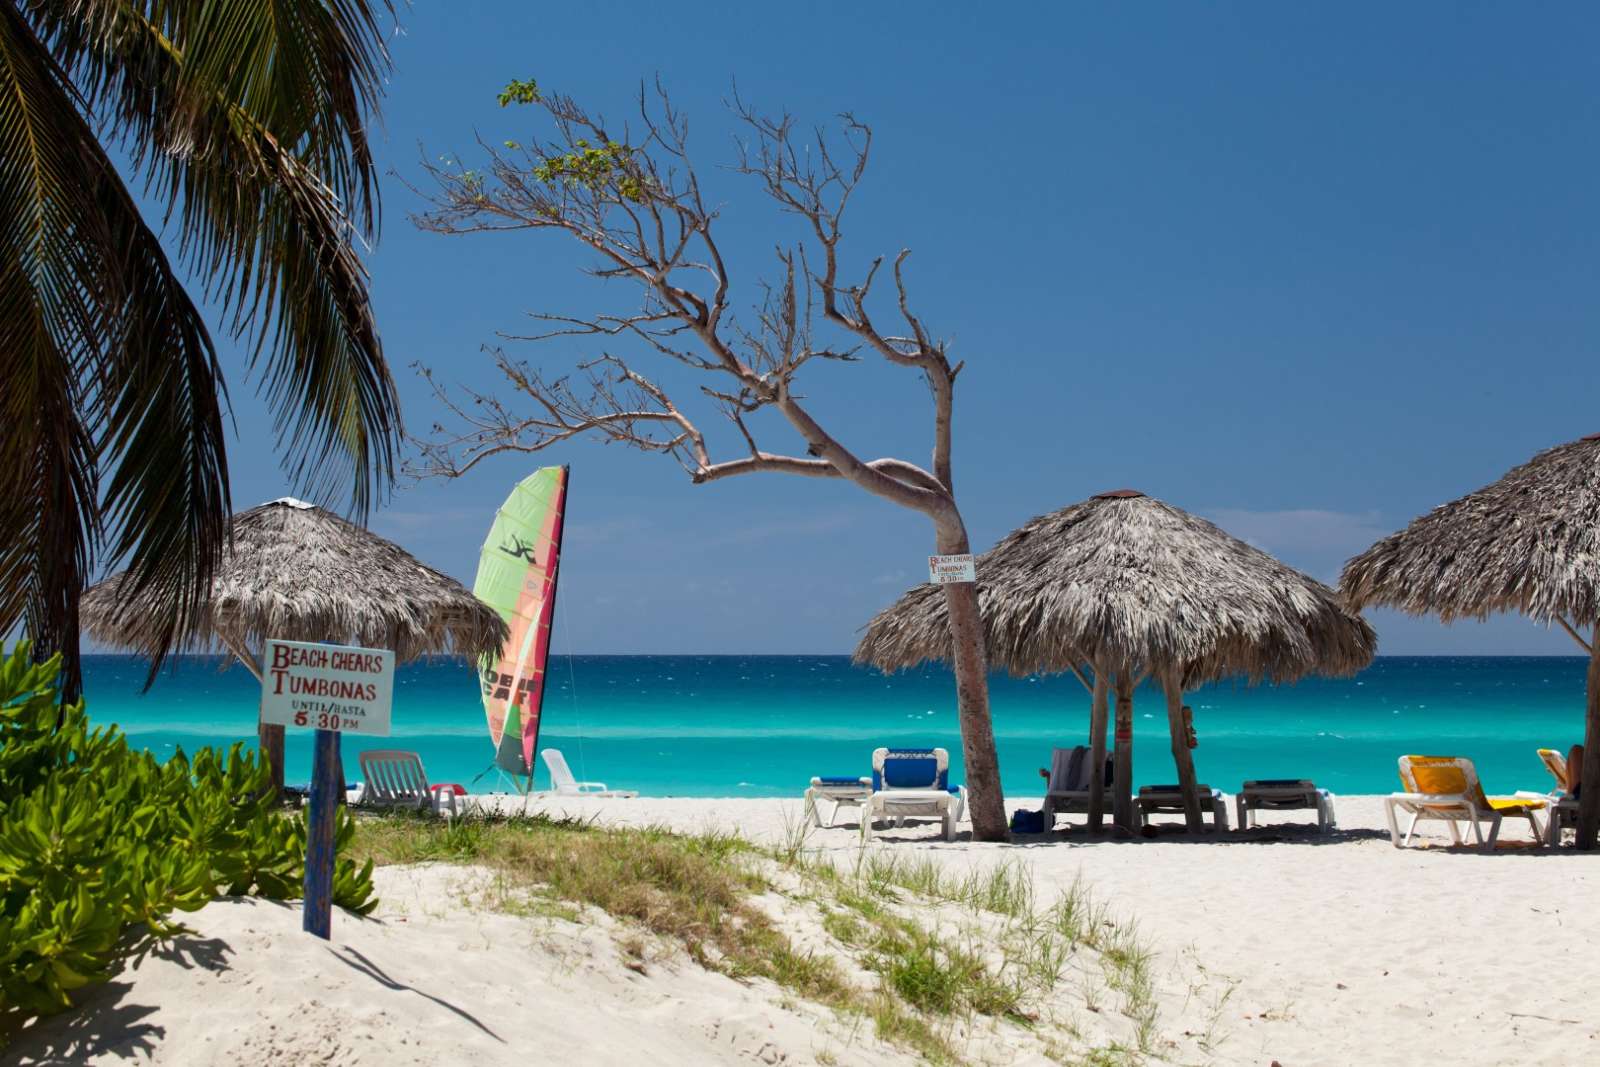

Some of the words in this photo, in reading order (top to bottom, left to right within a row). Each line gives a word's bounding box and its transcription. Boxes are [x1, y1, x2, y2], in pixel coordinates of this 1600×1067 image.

[272, 644, 328, 669] BEACH
[331, 652, 383, 673] CHEARS
[271, 669, 376, 701] TUMBONAS
[343, 719, 359, 729] PM
